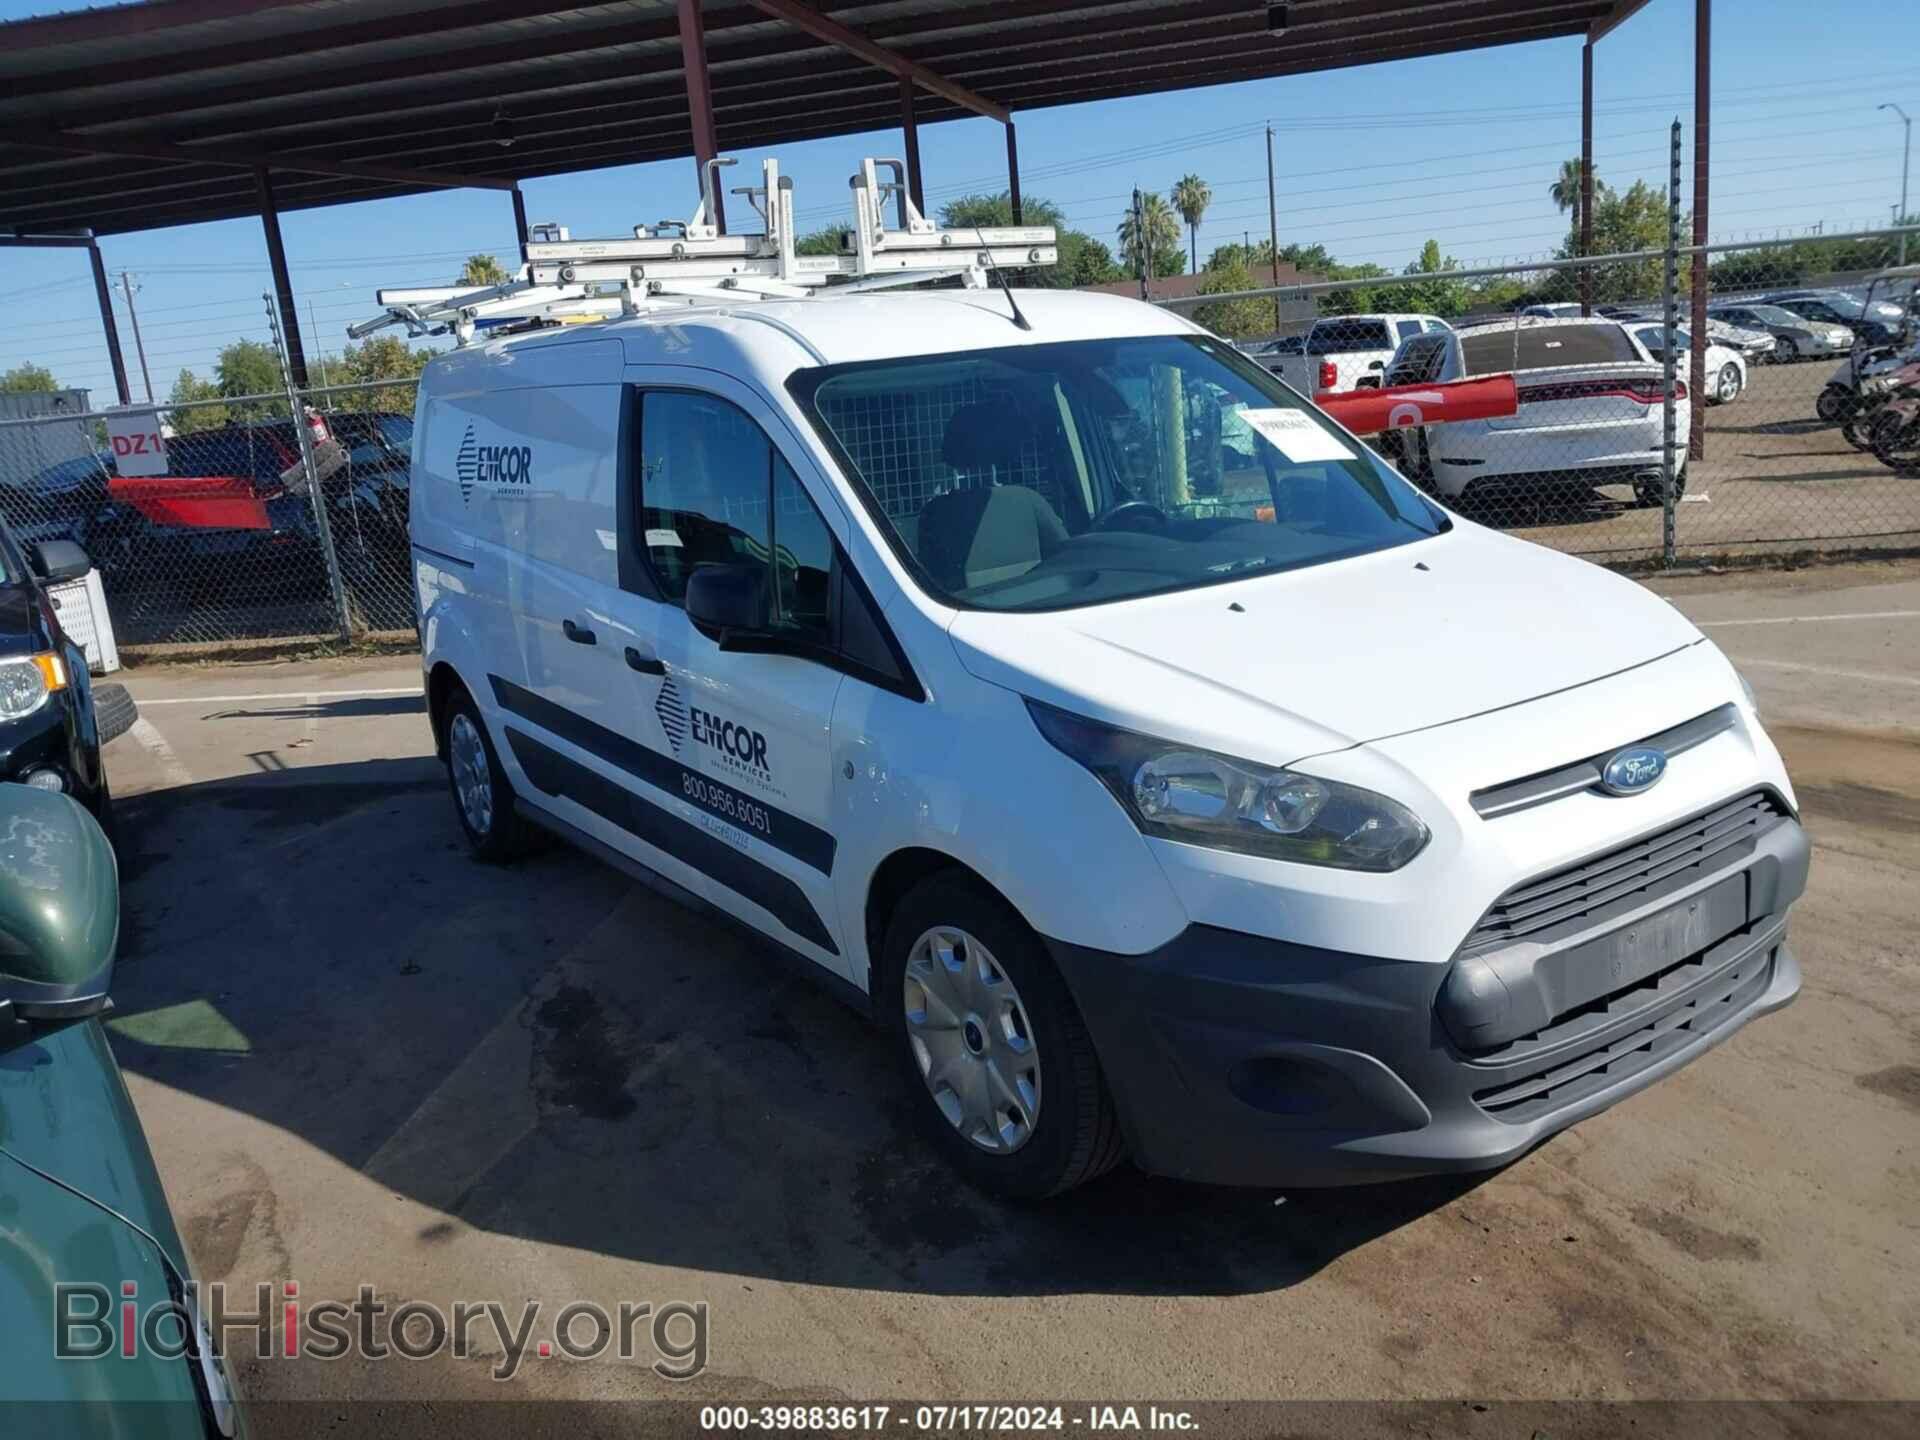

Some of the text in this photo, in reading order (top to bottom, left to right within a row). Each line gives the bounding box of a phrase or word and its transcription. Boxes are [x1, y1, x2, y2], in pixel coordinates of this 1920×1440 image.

[111, 433, 161, 456] DZ1
[477, 446, 531, 484] EMCOR
[690, 706, 769, 771] EMCOR
[723, 753, 771, 781] SERVICES
[1625, 756, 1659, 784] Ford
[682, 772, 771, 834] 800.956.6051
